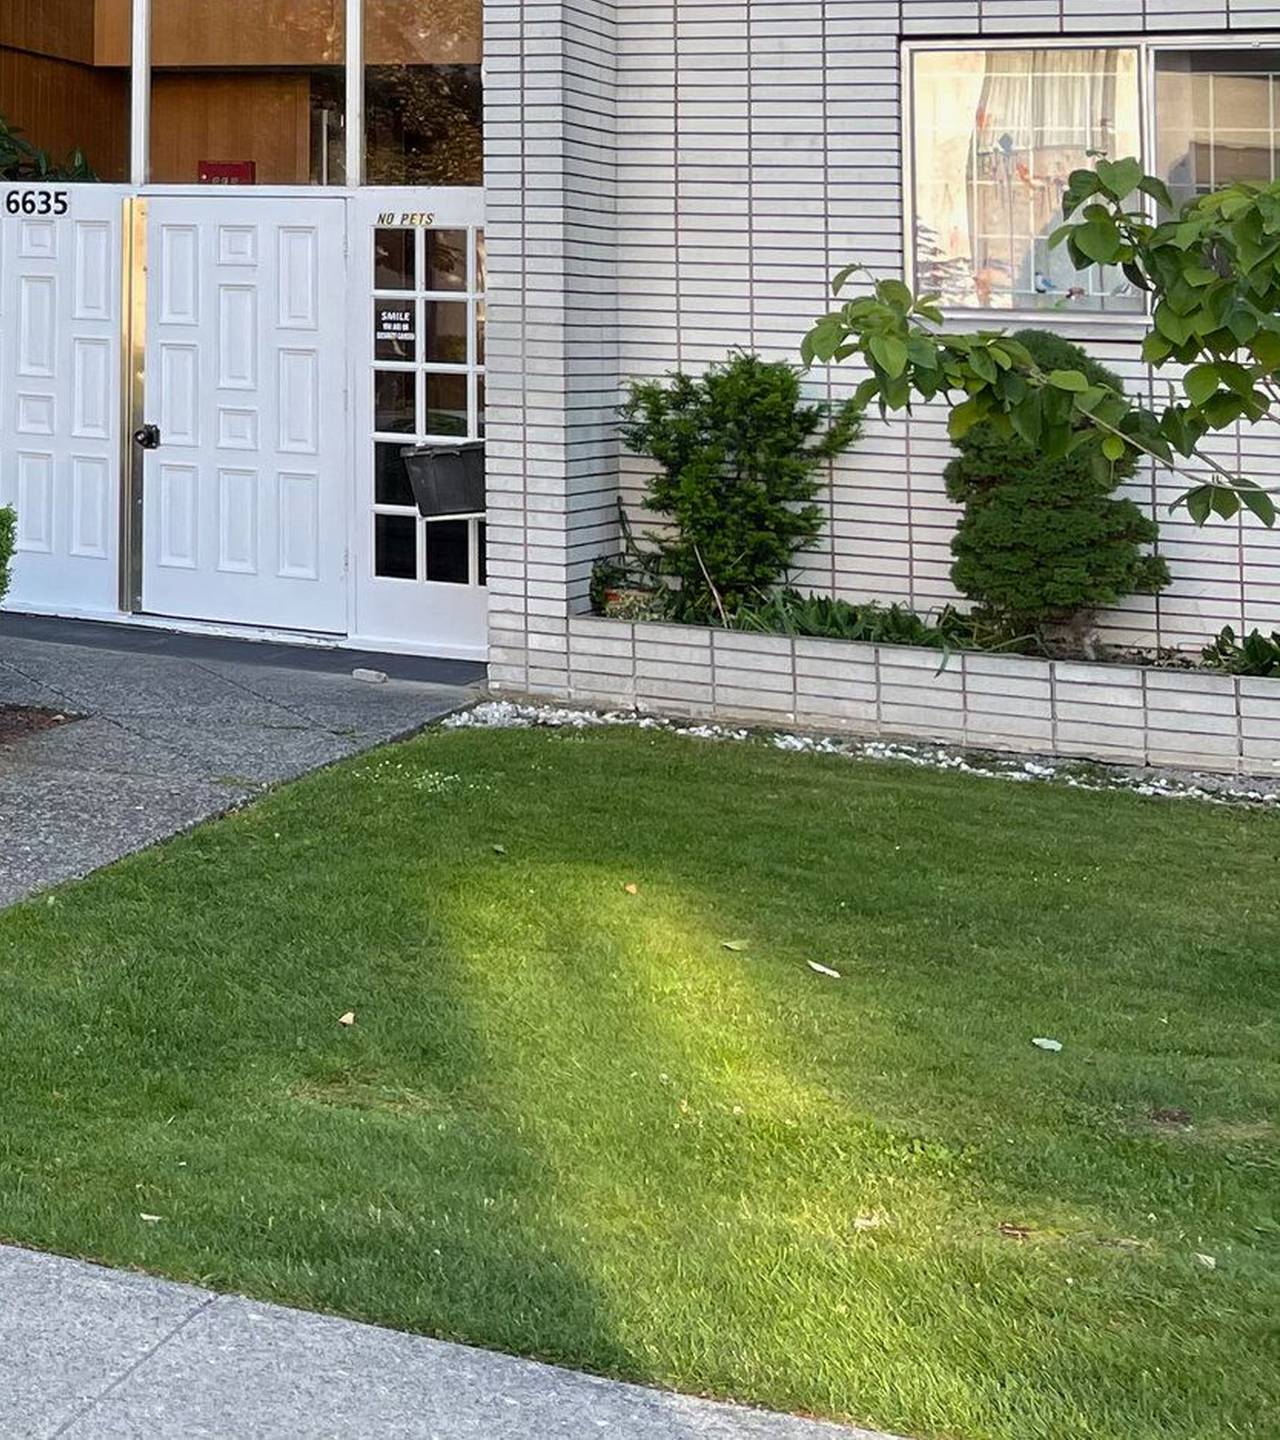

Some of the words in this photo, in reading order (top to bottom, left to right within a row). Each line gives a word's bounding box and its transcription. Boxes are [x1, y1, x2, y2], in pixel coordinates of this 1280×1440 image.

[6, 190, 68, 215] 6635
[377, 213, 394, 225] NO
[400, 212, 434, 225] PETS
[381, 311, 410, 321] SMILE
